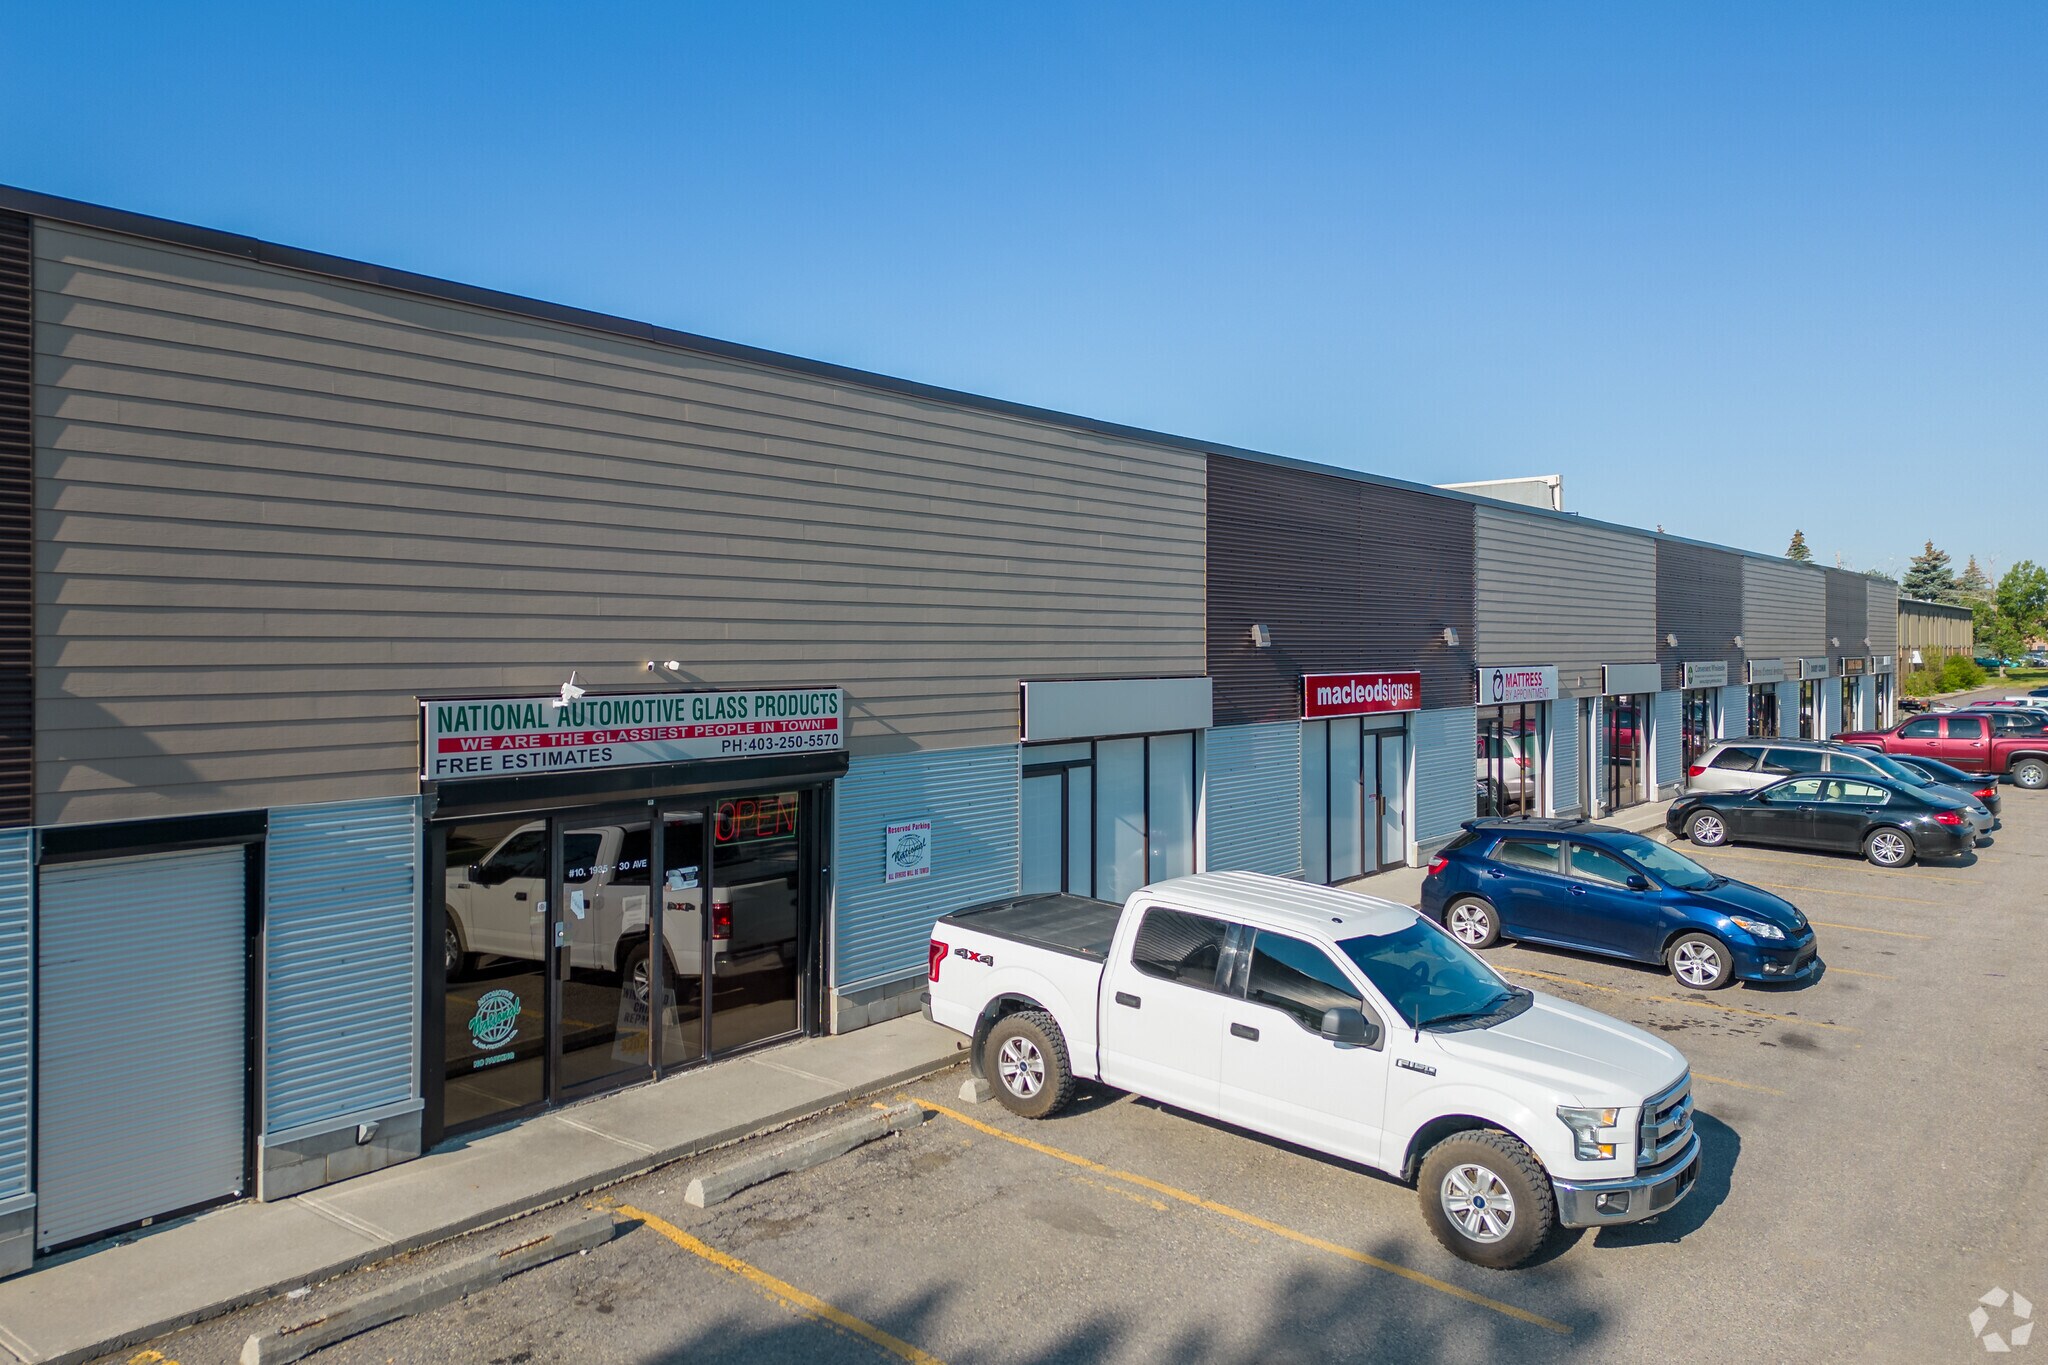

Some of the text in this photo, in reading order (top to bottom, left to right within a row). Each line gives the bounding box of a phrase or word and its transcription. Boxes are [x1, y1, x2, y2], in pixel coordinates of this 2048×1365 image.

[1317, 678, 1409, 706] macleodsigns
[1505, 672, 1542, 687] MATTRESS
[1505, 687, 1549, 700] BY APPOINTMENT
[437, 692, 838, 733] NATIONAL AUTOMOTIVE GLASS PRODUCTS
[460, 719, 825, 751] WE ARE THE GLASSIEST PEOPLE IN TOWN!
[436, 747, 613, 774] FREE ESTIMATES
[715, 796, 795, 840] OPEN
[888, 822, 930, 834] Reserved Parking
[892, 838, 926, 862] National
[589, 864, 608, 875] 1935
[619, 861, 630, 871] 30
[633, 859, 648, 869] AVE
[468, 996, 522, 1038] National
[473, 1051, 515, 1068] NO PARKING
